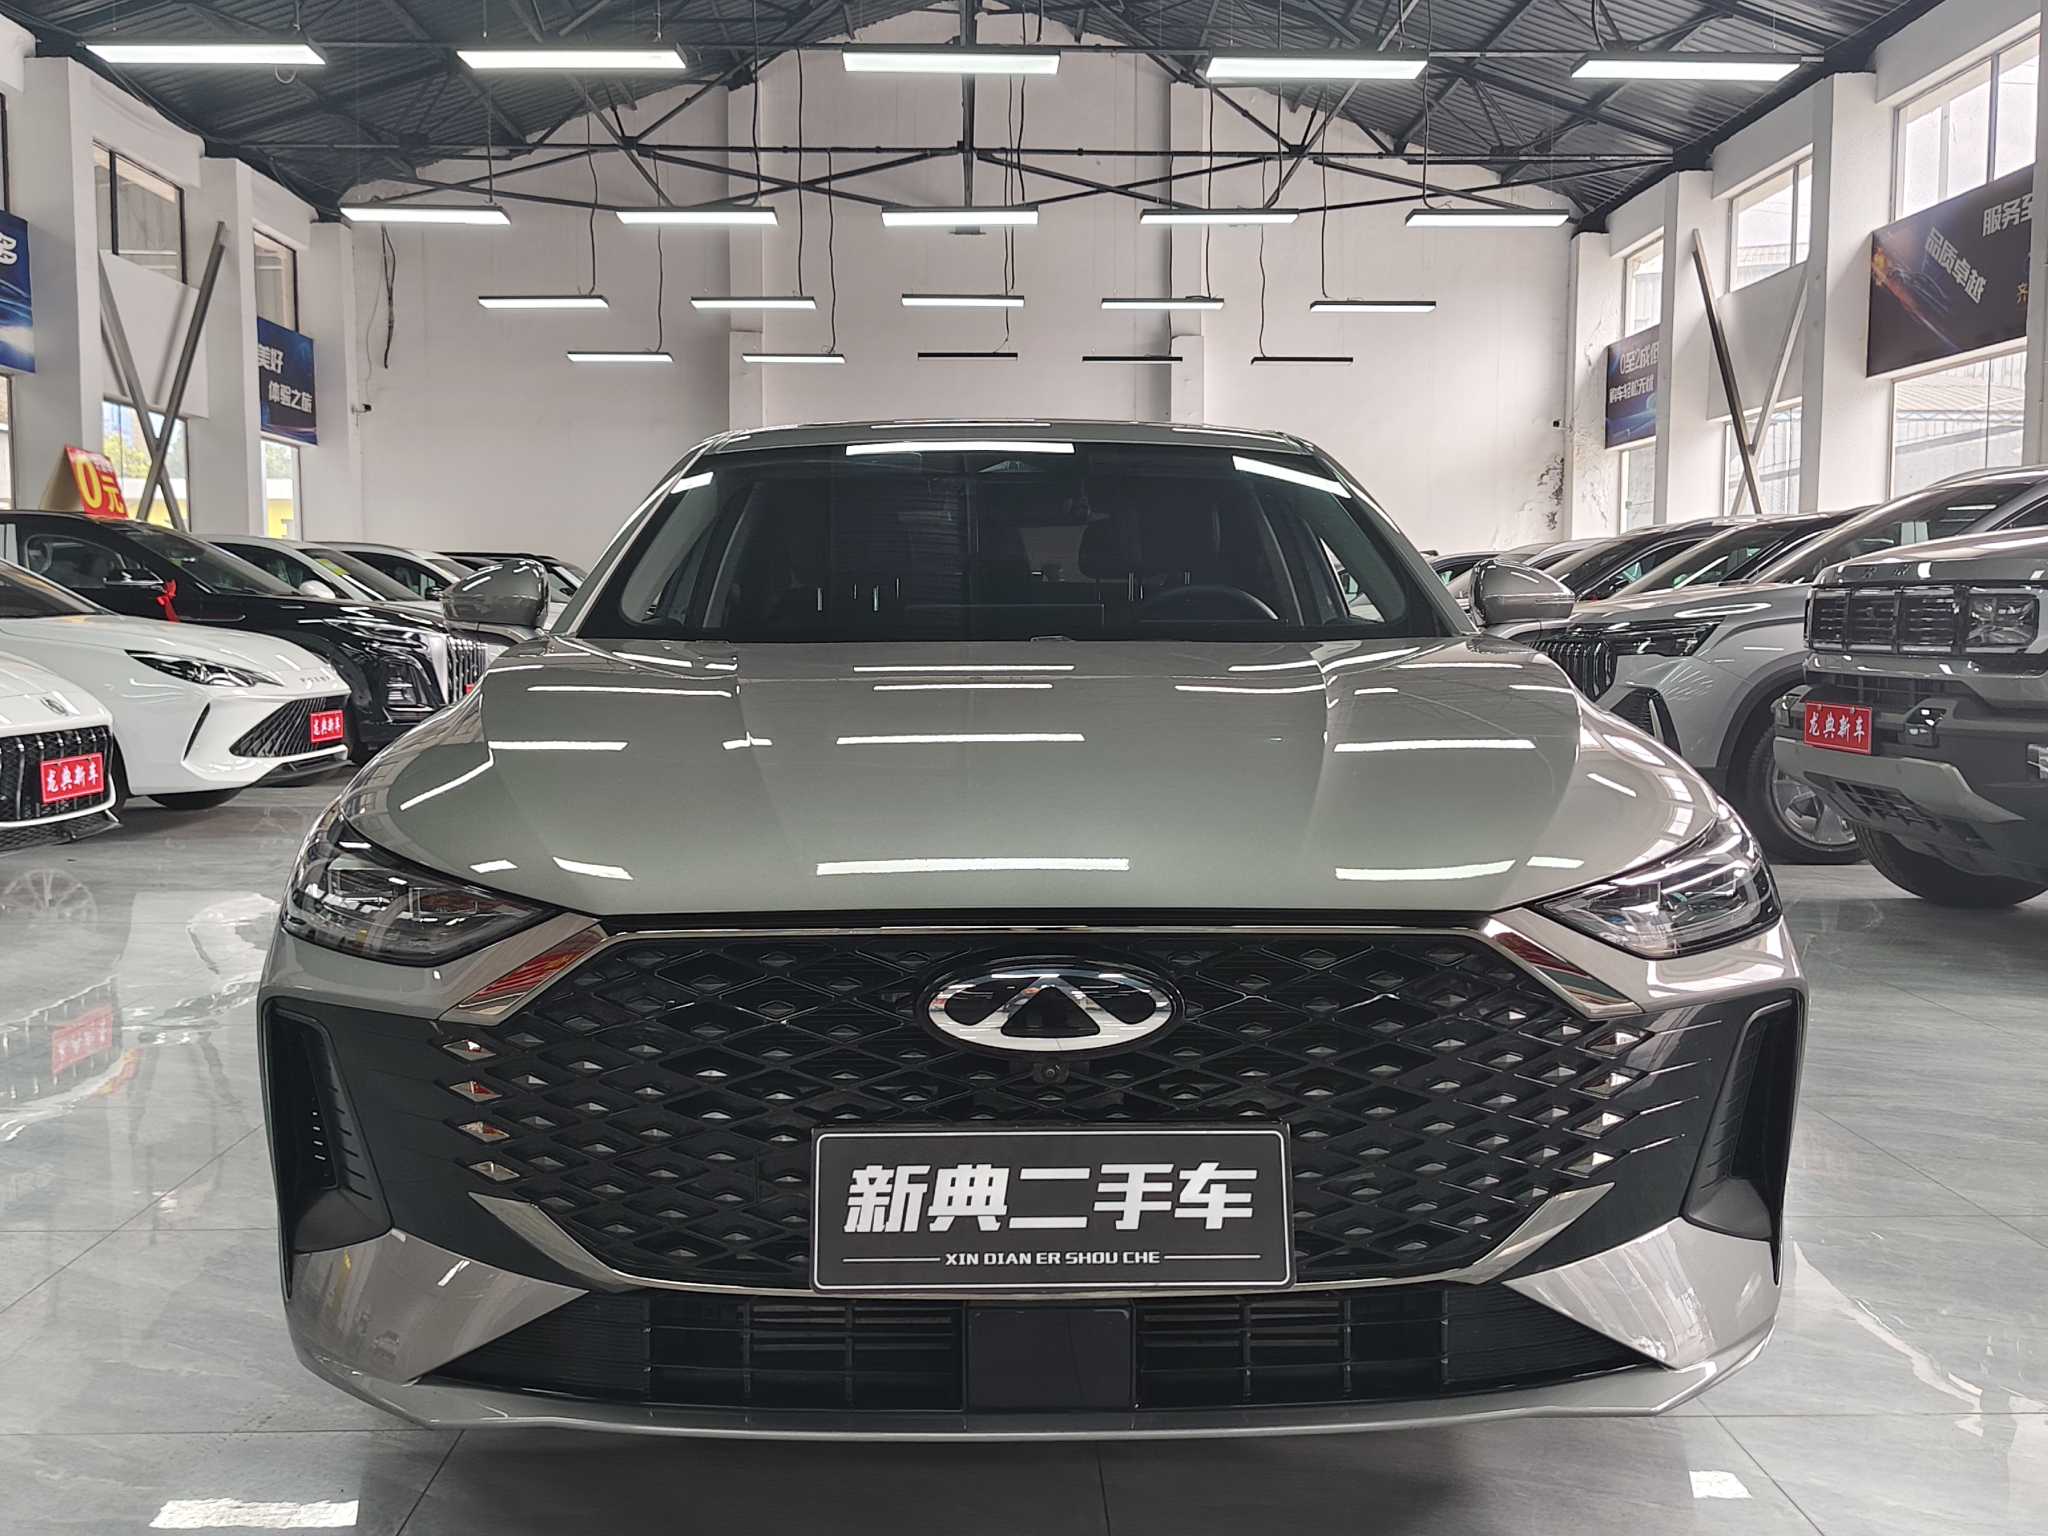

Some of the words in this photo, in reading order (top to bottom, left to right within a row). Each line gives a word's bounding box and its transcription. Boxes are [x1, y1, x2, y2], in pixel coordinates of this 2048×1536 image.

[1925, 226, 1987, 304] 品质卓越
[843, 1162, 1259, 1233] 新典二手车
[945, 1253, 979, 1266] XIN
[983, 1252, 1032, 1266] DIAN
[1035, 1252, 1061, 1265] ER
[1065, 1251, 1118, 1265] SHOU
[1122, 1251, 1160, 1265] CHE
